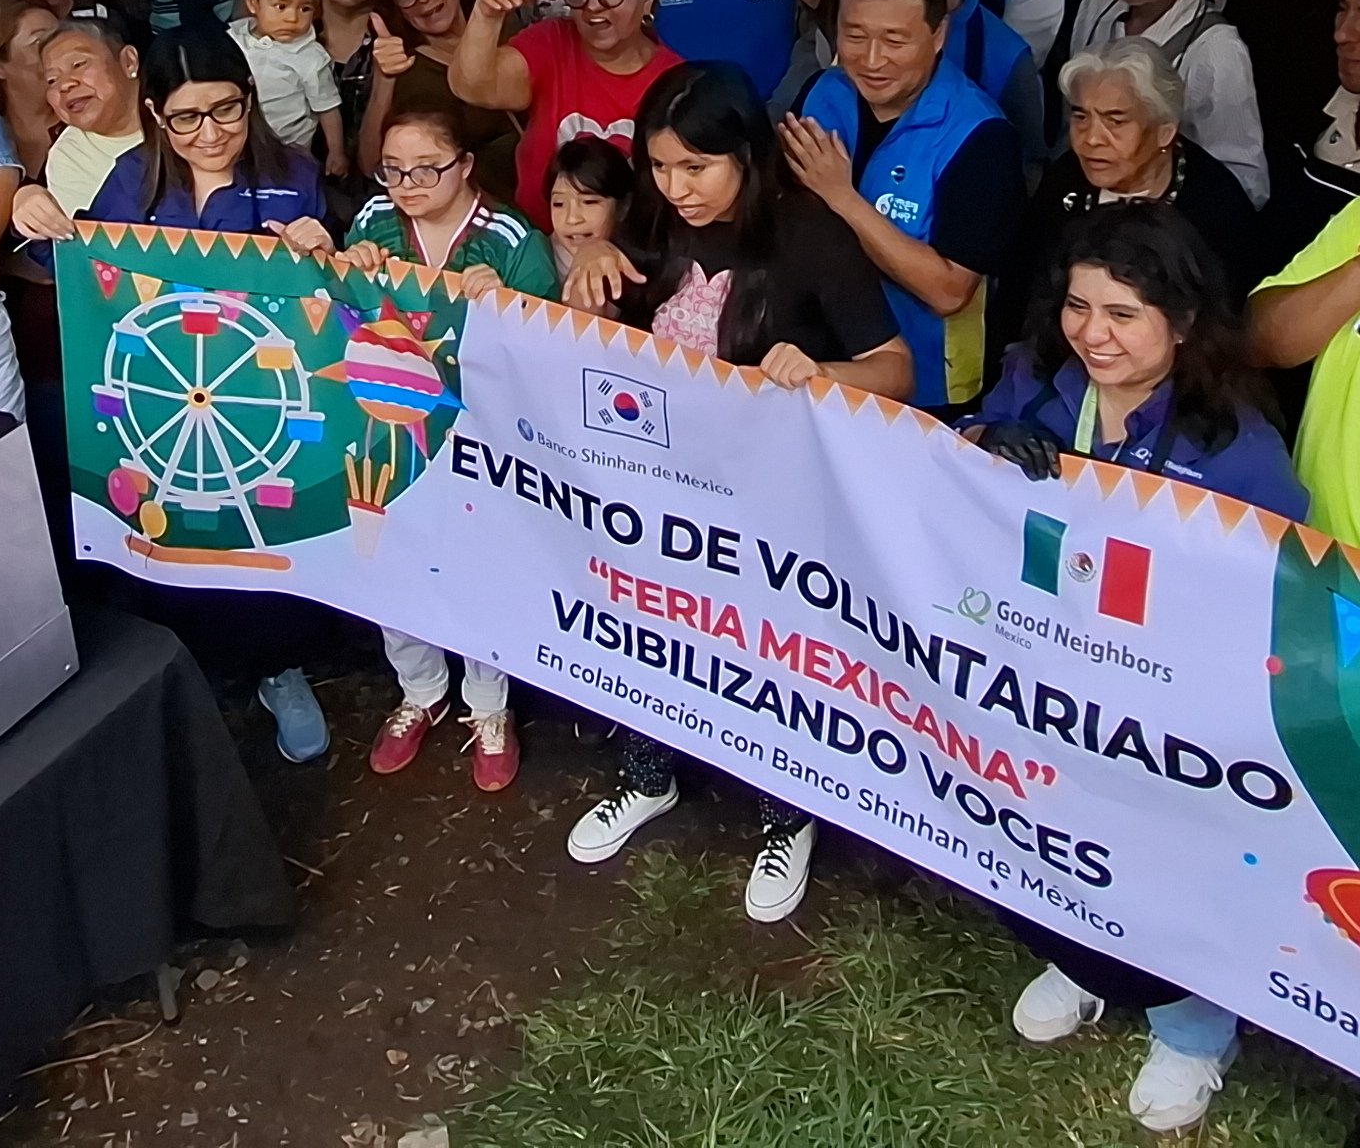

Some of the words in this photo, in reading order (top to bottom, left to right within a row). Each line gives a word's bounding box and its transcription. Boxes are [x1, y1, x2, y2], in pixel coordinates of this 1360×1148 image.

[537, 431, 576, 459] Banco
[581, 448, 647, 476] Shinhan
[652, 465, 671, 481] de
[451, 434, 643, 546] EVENTO
[661, 513, 741, 575] DE
[756, 539, 1293, 811] VOLUNTARIADO
[551, 589, 907, 775] VISIBILIZANDO
[919, 751, 1113, 888] VOCES
[589, 556, 747, 650] “FERIA
[759, 619, 1056, 800] MEXICANA”
[995, 623, 1032, 650] Mexico
[996, 601, 1050, 638] Good
[1054, 624, 1174, 684] Neighbors
[536, 644, 563, 672] En
[569, 662, 713, 738] colaboración
[721, 729, 763, 761] con
[772, 748, 850, 800] Banco
[858, 789, 968, 859] Shinhan
[977, 850, 1011, 880] de
[1020, 868, 1125, 938] México
